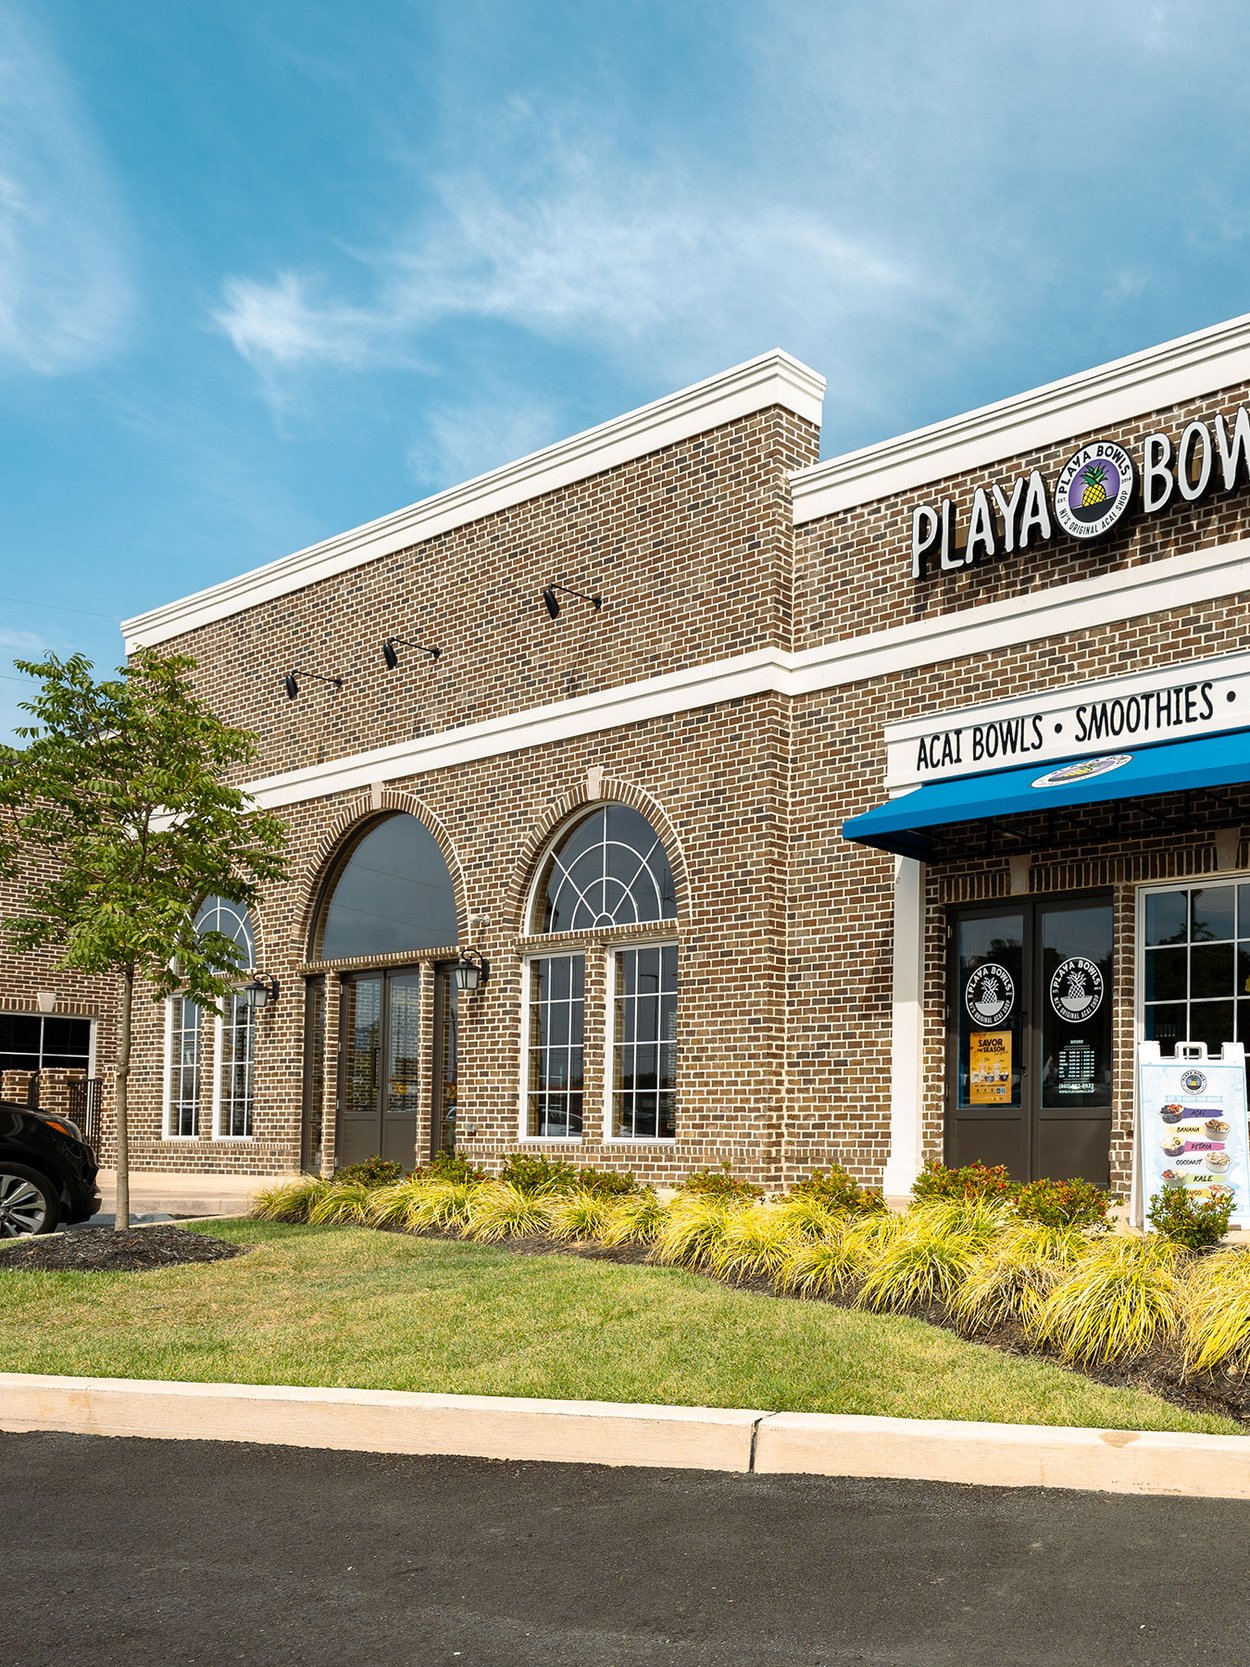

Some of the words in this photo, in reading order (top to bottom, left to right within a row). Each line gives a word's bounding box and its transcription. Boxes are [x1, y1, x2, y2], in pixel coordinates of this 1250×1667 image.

[1058, 451, 1091, 494] PLAYA
[1096, 446, 1130, 476] BOWLS
[911, 470, 1052, 579] PLAYA
[1059, 508, 1071, 525] NJ'S
[1069, 521, 1098, 535] ORIGINAL
[1101, 512, 1117, 529] ACAI
[1116, 490, 1128, 512] SHOP
[916, 729, 963, 771] ACAI
[972, 715, 1044, 758] BOWLS
[1074, 683, 1215, 743] SMOOTHIES
[968, 967, 989, 993] PLAYA
[990, 966, 1012, 991] BOWLS
[1053, 961, 1075, 988] PLAYA
[1078, 960, 1101, 985] BOWLS
[978, 1038, 1003, 1047] SAVOR
